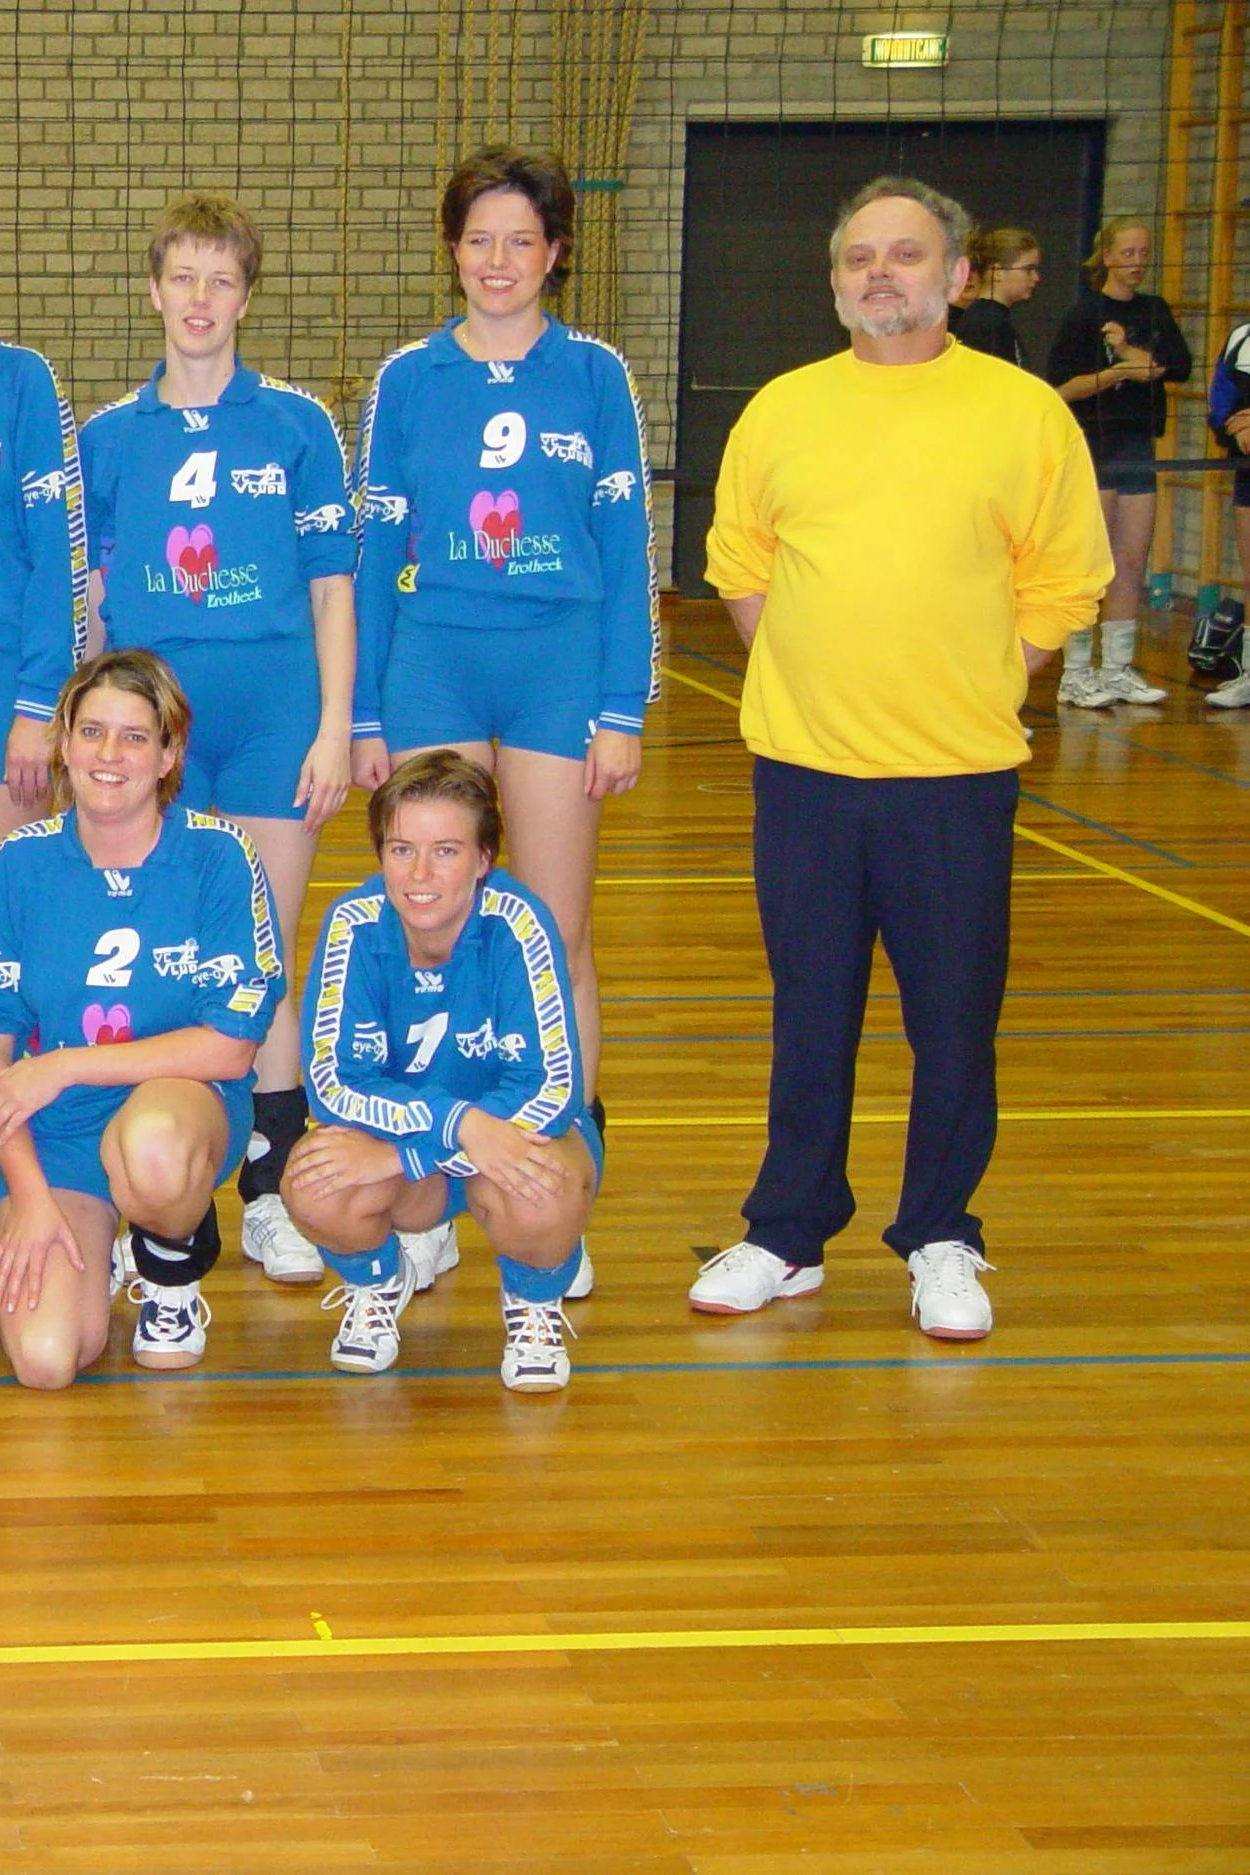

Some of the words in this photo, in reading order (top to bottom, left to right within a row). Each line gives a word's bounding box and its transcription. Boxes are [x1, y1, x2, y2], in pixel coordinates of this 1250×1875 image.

[479, 411, 527, 469] 9
[168, 451, 217, 509] 4
[448, 531, 467, 560] La
[473, 528, 561, 560] Duchesse
[143, 564, 166, 593] La
[171, 562, 259, 595] Duchesse
[85, 928, 140, 987] 2
